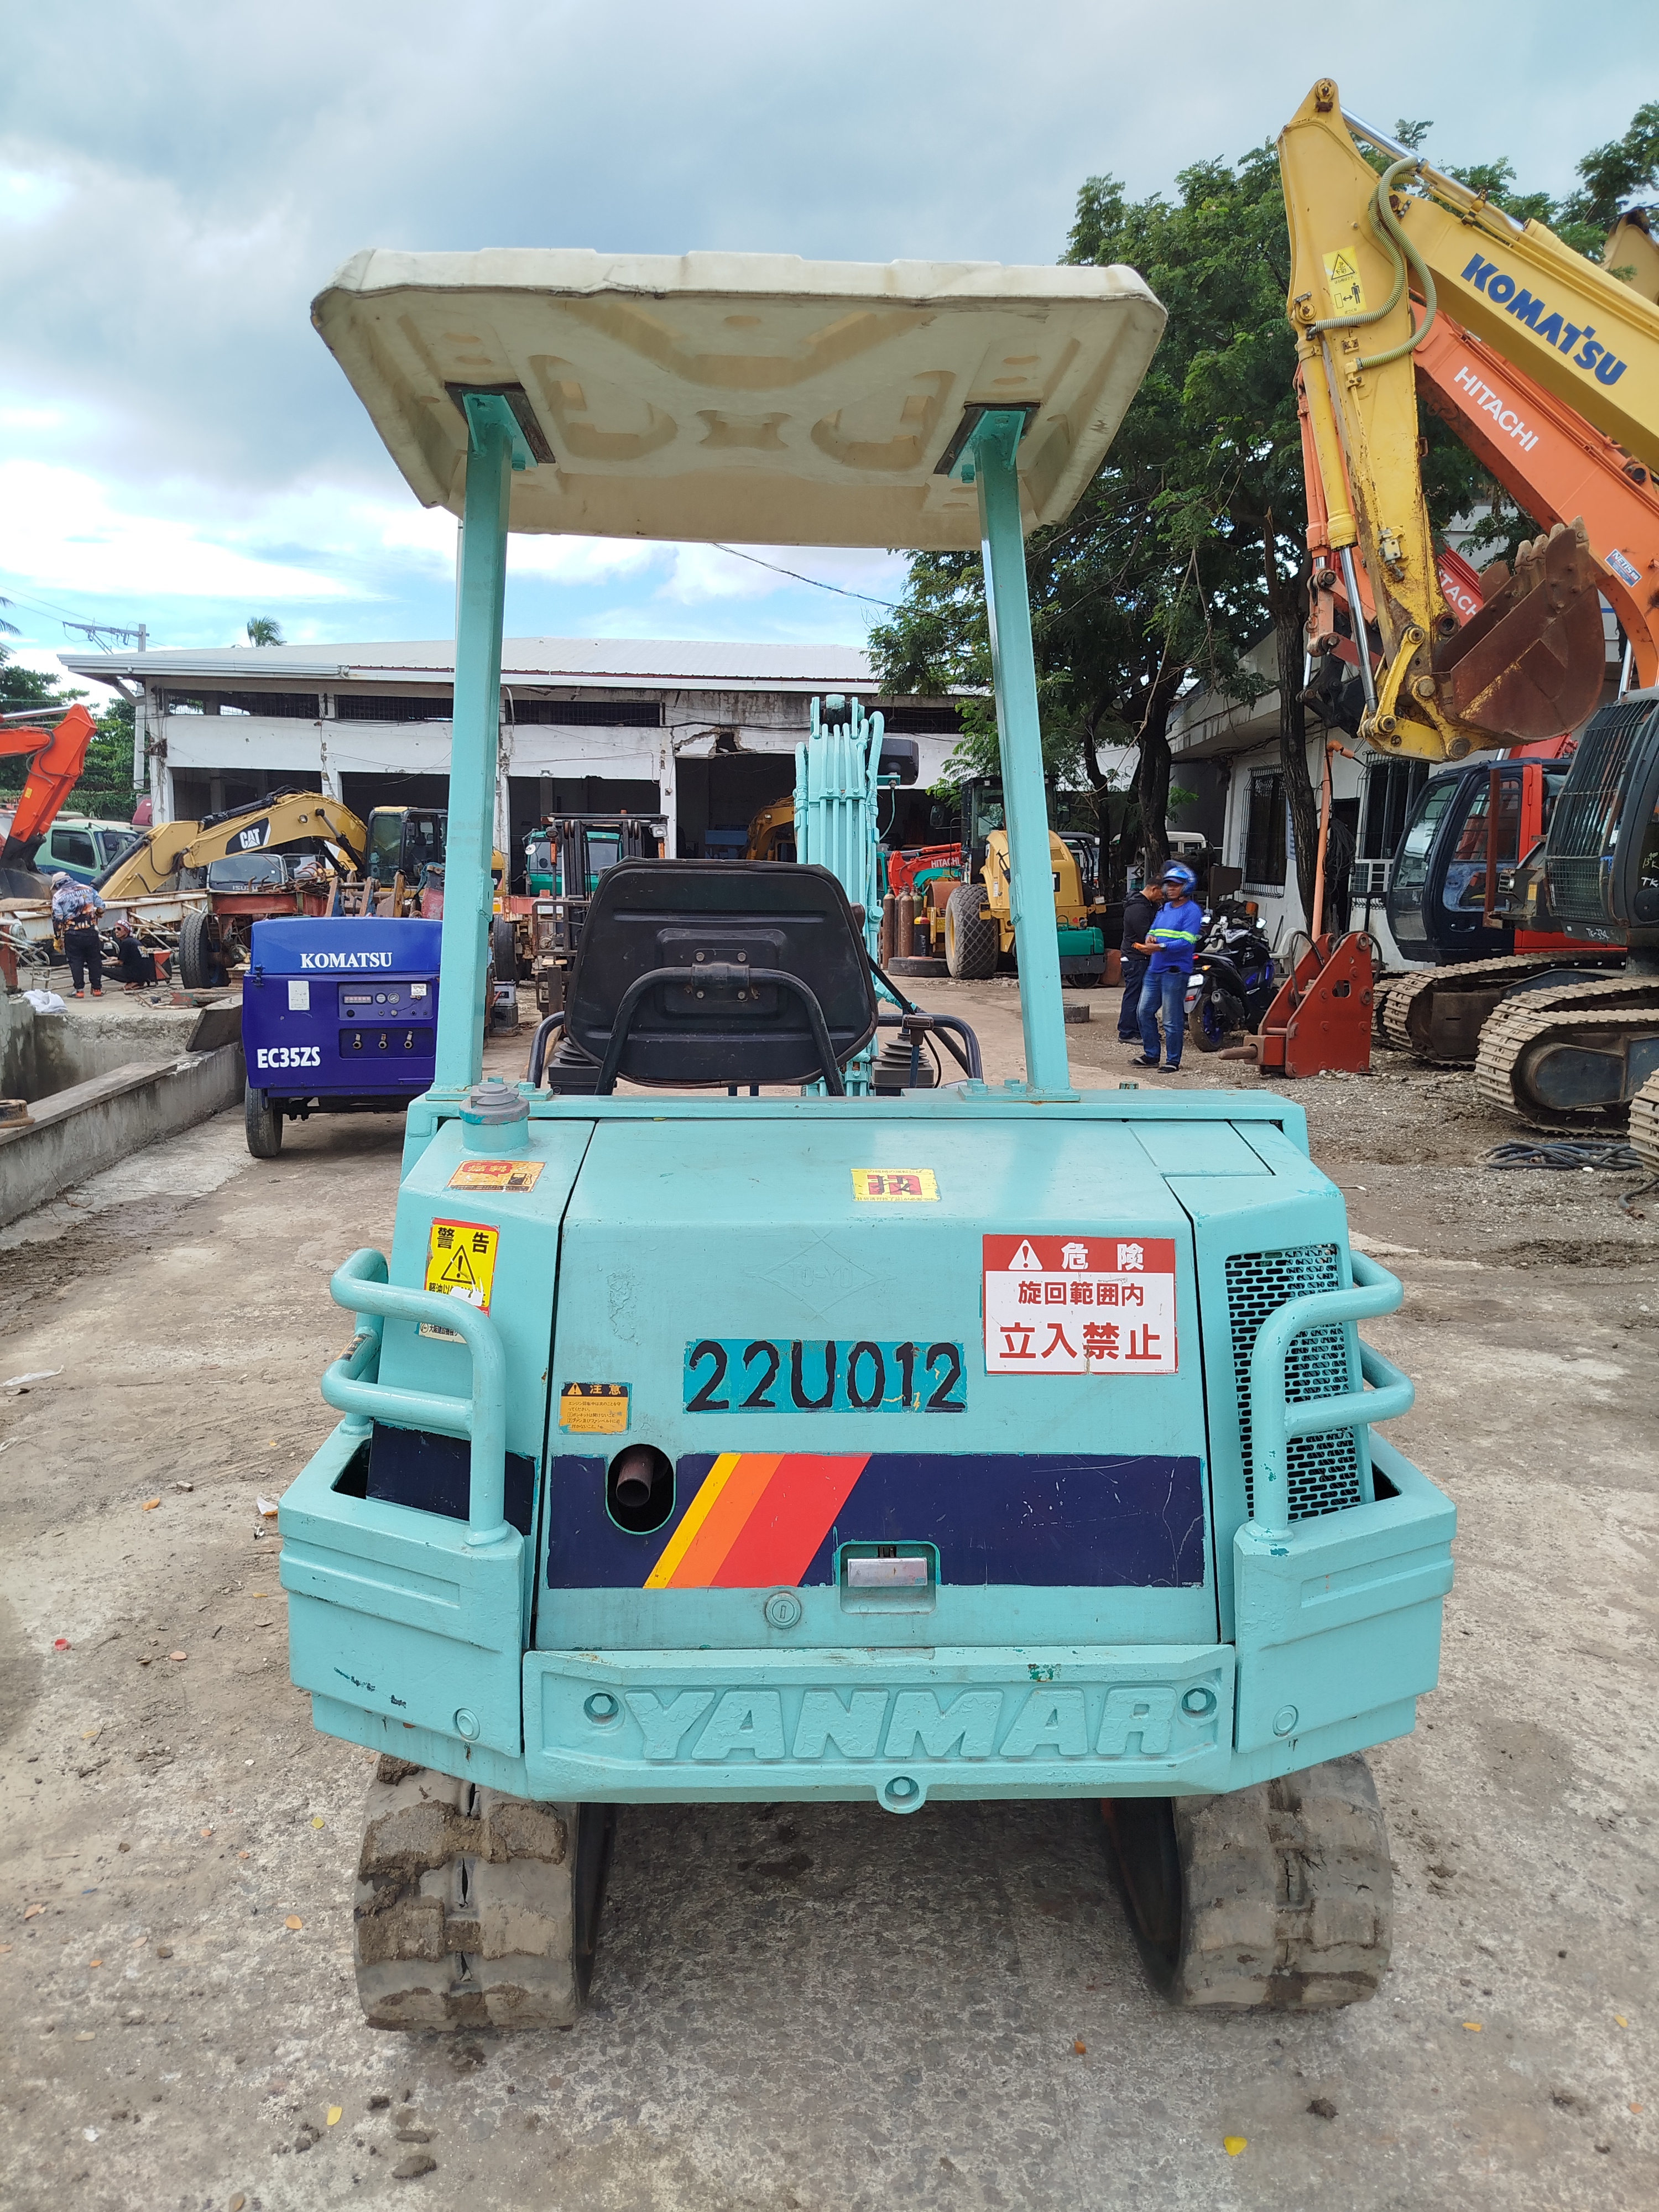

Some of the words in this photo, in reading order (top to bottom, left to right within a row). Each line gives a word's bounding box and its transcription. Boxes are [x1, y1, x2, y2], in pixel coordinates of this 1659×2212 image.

[1461, 253, 1627, 385] KOMATSU
[1454, 366, 1539, 452] HITACHI
[239, 828, 260, 849] CAT
[931, 857, 961, 868] HITACHI
[300, 952, 393, 968] KOMATSU
[257, 1046, 321, 1068] EC35ZS
[437, 1227, 489, 1254] 警告
[1061, 1242, 1144, 1271] 危険
[1018, 1281, 1144, 1307] 旋回範囲内
[999, 1322, 1162, 1360] 立入禁止
[589, 1384, 621, 1395] 注意
[686, 1340, 966, 1412] 22U012
[623, 1684, 1177, 1760] YANMAR
